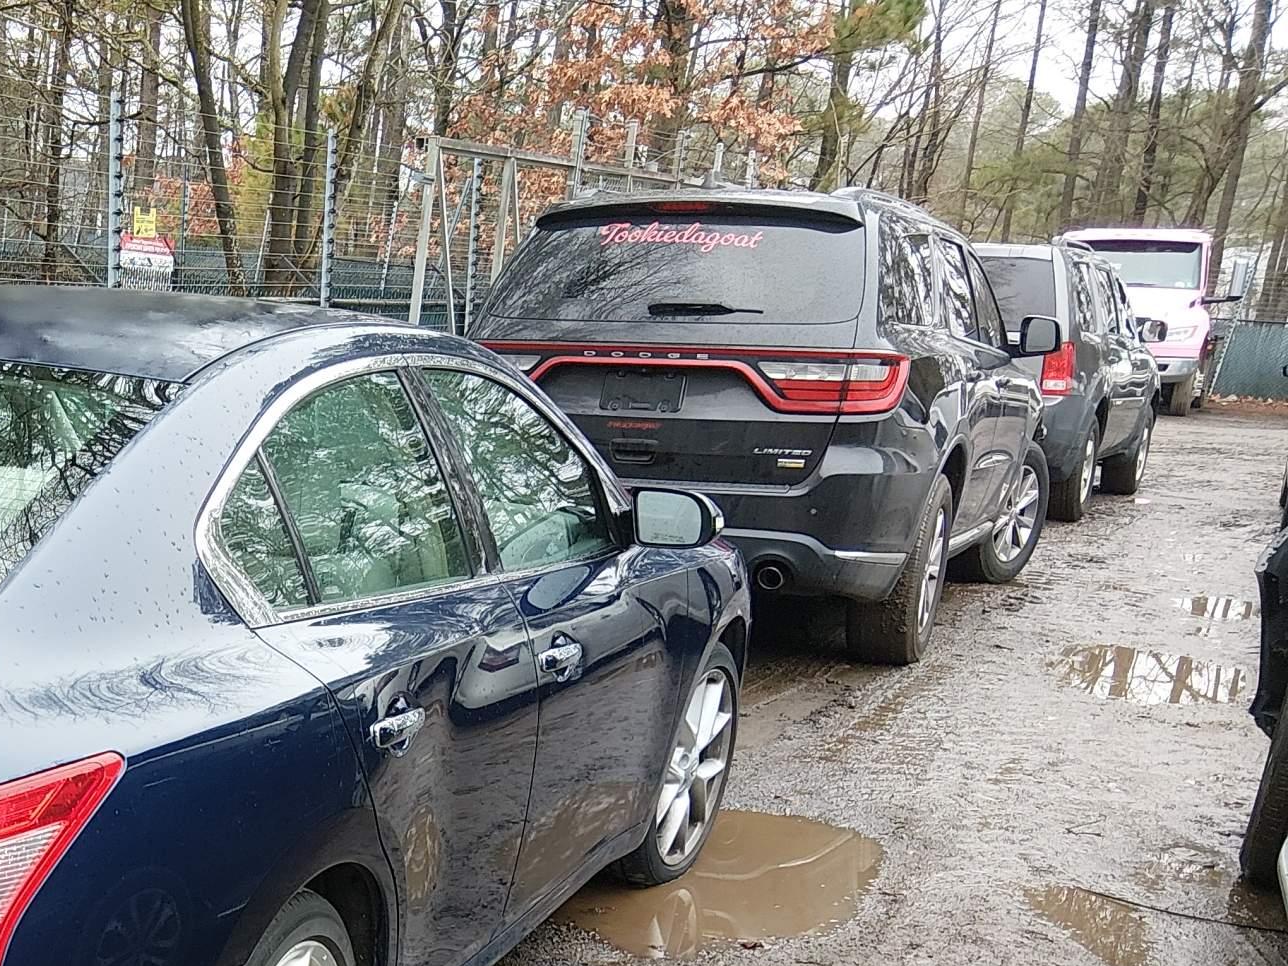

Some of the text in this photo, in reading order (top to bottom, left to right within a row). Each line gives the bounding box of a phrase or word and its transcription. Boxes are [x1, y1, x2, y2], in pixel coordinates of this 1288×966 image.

[600, 221, 762, 252] Tookiedagoat
[583, 350, 709, 359] DODGE
[753, 448, 812, 456] LIMITED
